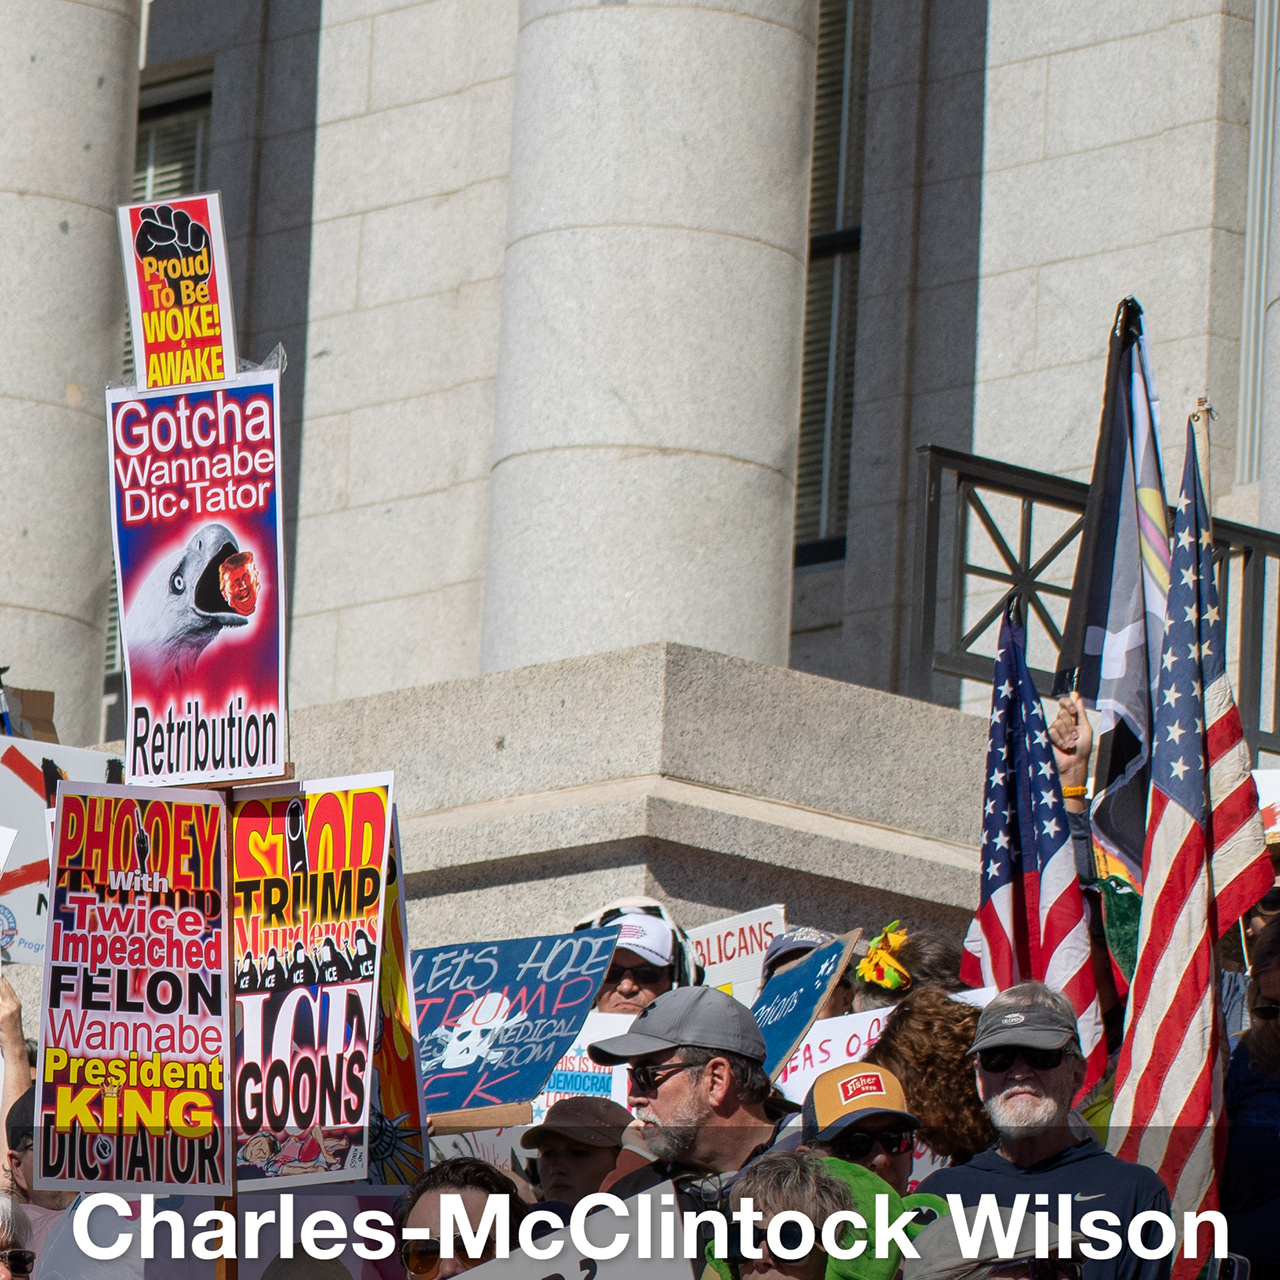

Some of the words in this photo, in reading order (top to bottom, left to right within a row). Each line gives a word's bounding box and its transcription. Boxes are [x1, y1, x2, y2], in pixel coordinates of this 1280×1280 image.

[143, 248, 209, 281] Proud
[148, 284, 174, 308] To
[181, 281, 208, 304] Be
[143, 304, 221, 343] WOKE!
[181, 340, 187, 348] &
[147, 345, 224, 387] AWAKE
[115, 391, 270, 455] Gotcha
[116, 445, 274, 489] Wannabe
[132, 698, 276, 776] Retribution
[58, 794, 220, 893] PHOOEY
[109, 870, 168, 893] With
[235, 868, 380, 927] TRUMP
[69, 896, 203, 936] Twice
[234, 911, 378, 960] Murderous
[18, 938, 44, 953] Progr
[52, 922, 221, 974] Impeached
[516, 934, 618, 982] HOPE
[49, 967, 221, 1017] FELON
[265, 975, 275, 988] ICE
[293, 969, 304, 983] ICE
[325, 967, 338, 982] ICE
[360, 960, 374, 976] ICE
[415, 976, 594, 1028] TRUMP
[49, 1009, 221, 1054] Wannabe
[44, 1047, 223, 1091] President
[578, 1057, 589, 1072] IS
[846, 1077, 876, 1096] Fisher
[238, 1049, 366, 1135] GOONS
